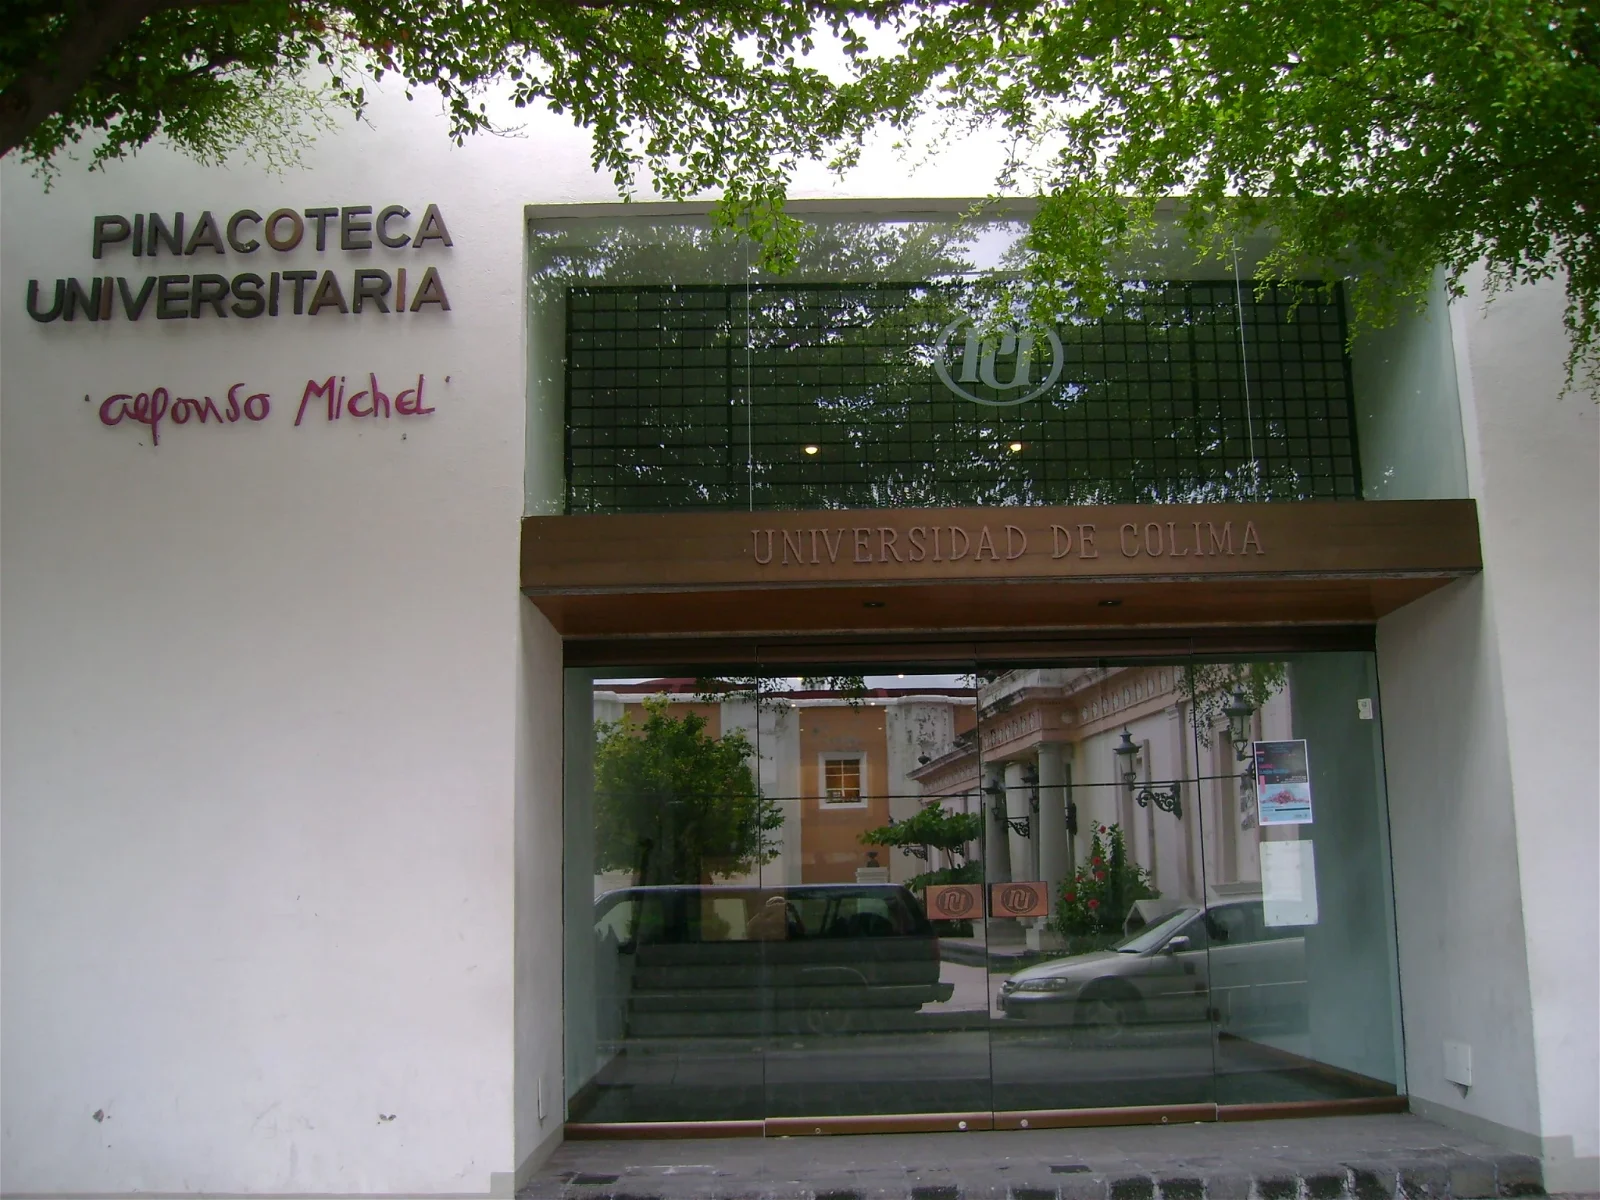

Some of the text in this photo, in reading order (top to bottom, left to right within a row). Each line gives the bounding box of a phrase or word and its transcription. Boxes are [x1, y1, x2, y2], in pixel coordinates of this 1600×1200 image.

[92, 203, 453, 259] PINACOTECA
[26, 266, 451, 323] UNIVERSITARIA
[750, 520, 1265, 566] UNIVERSIDAD DE COLIMA
